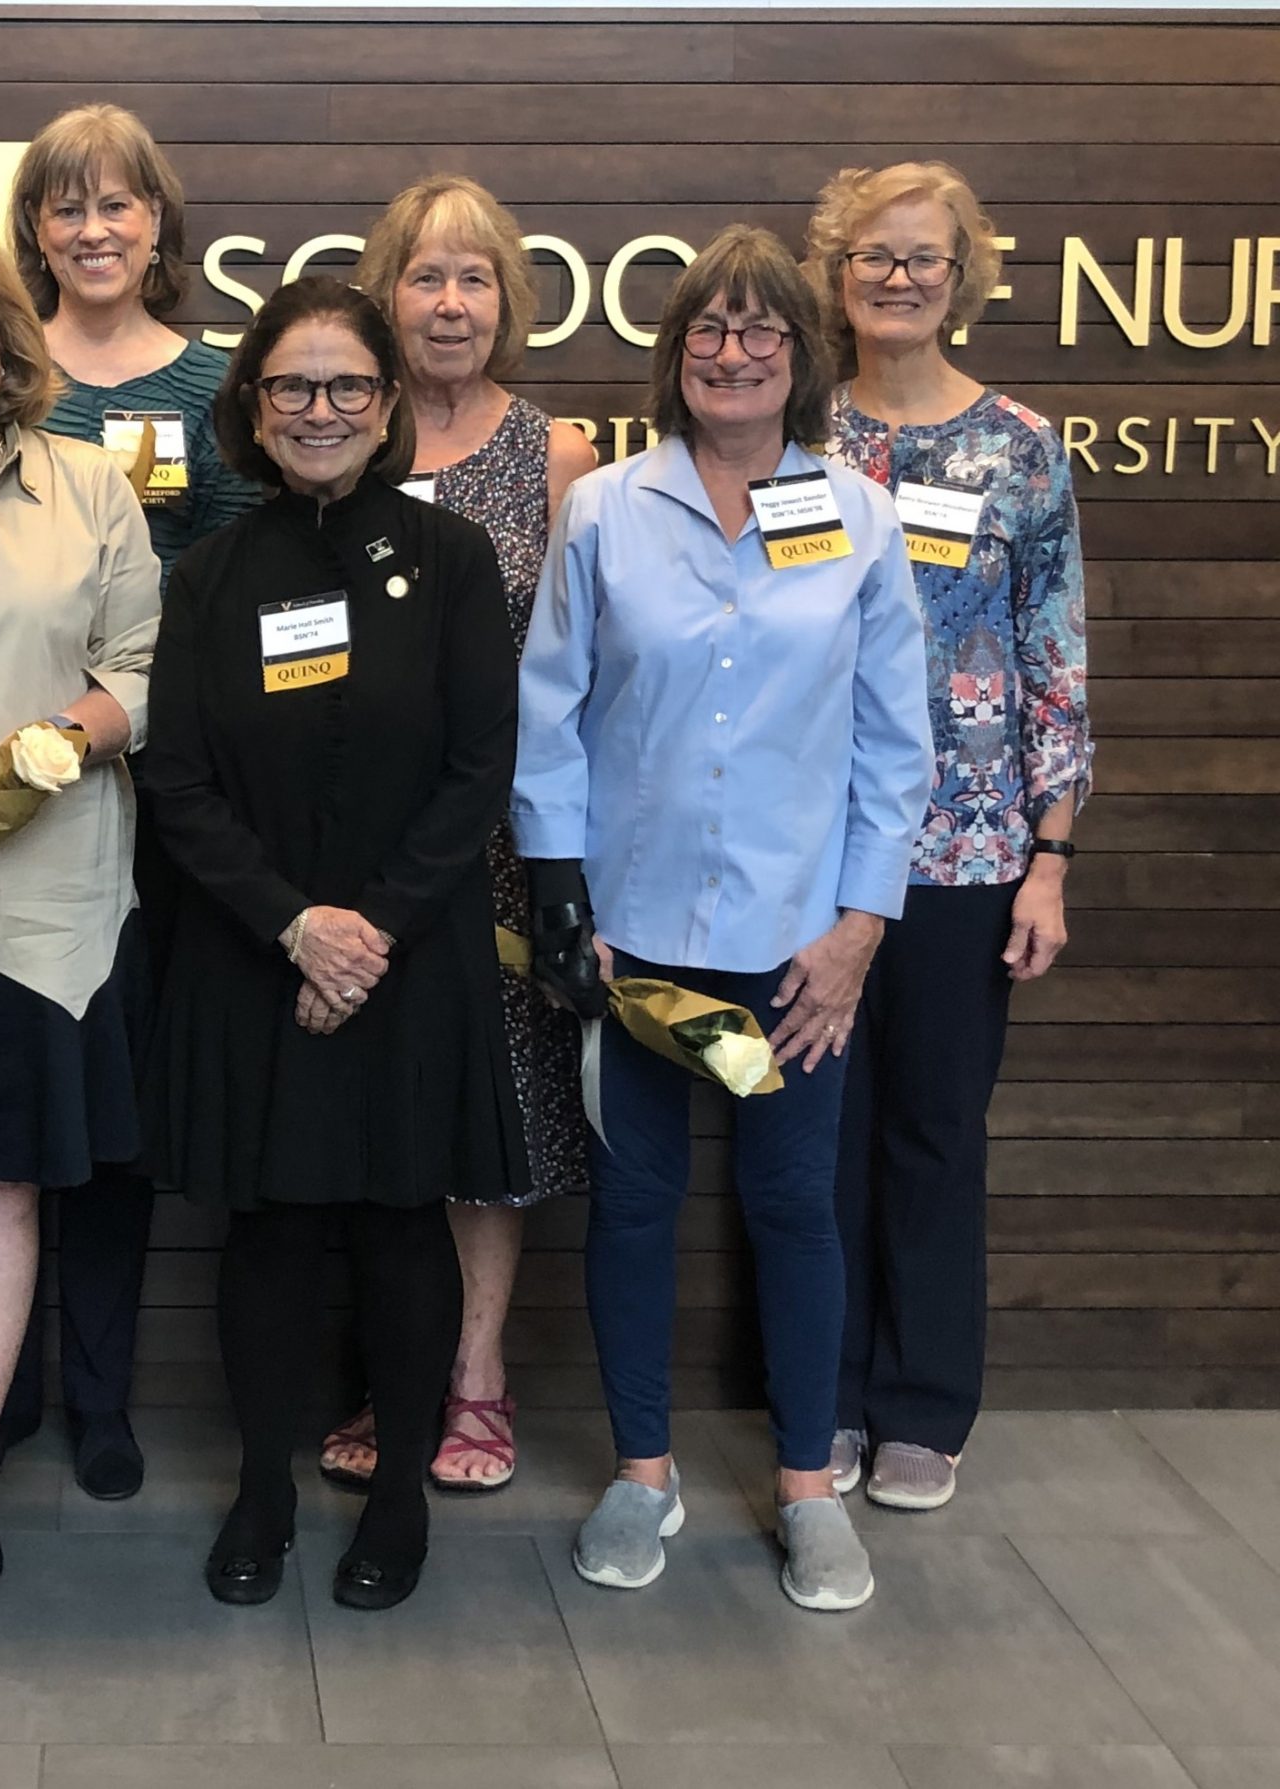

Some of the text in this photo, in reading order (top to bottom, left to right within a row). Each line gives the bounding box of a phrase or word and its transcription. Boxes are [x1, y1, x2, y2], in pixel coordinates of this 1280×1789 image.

[1063, 416, 1280, 475] RSITY
[780, 539, 833, 560] QUINQ
[276, 623, 297, 631] Marie
[313, 617, 334, 625] Smith
[277, 661, 331, 682] QUINQ
